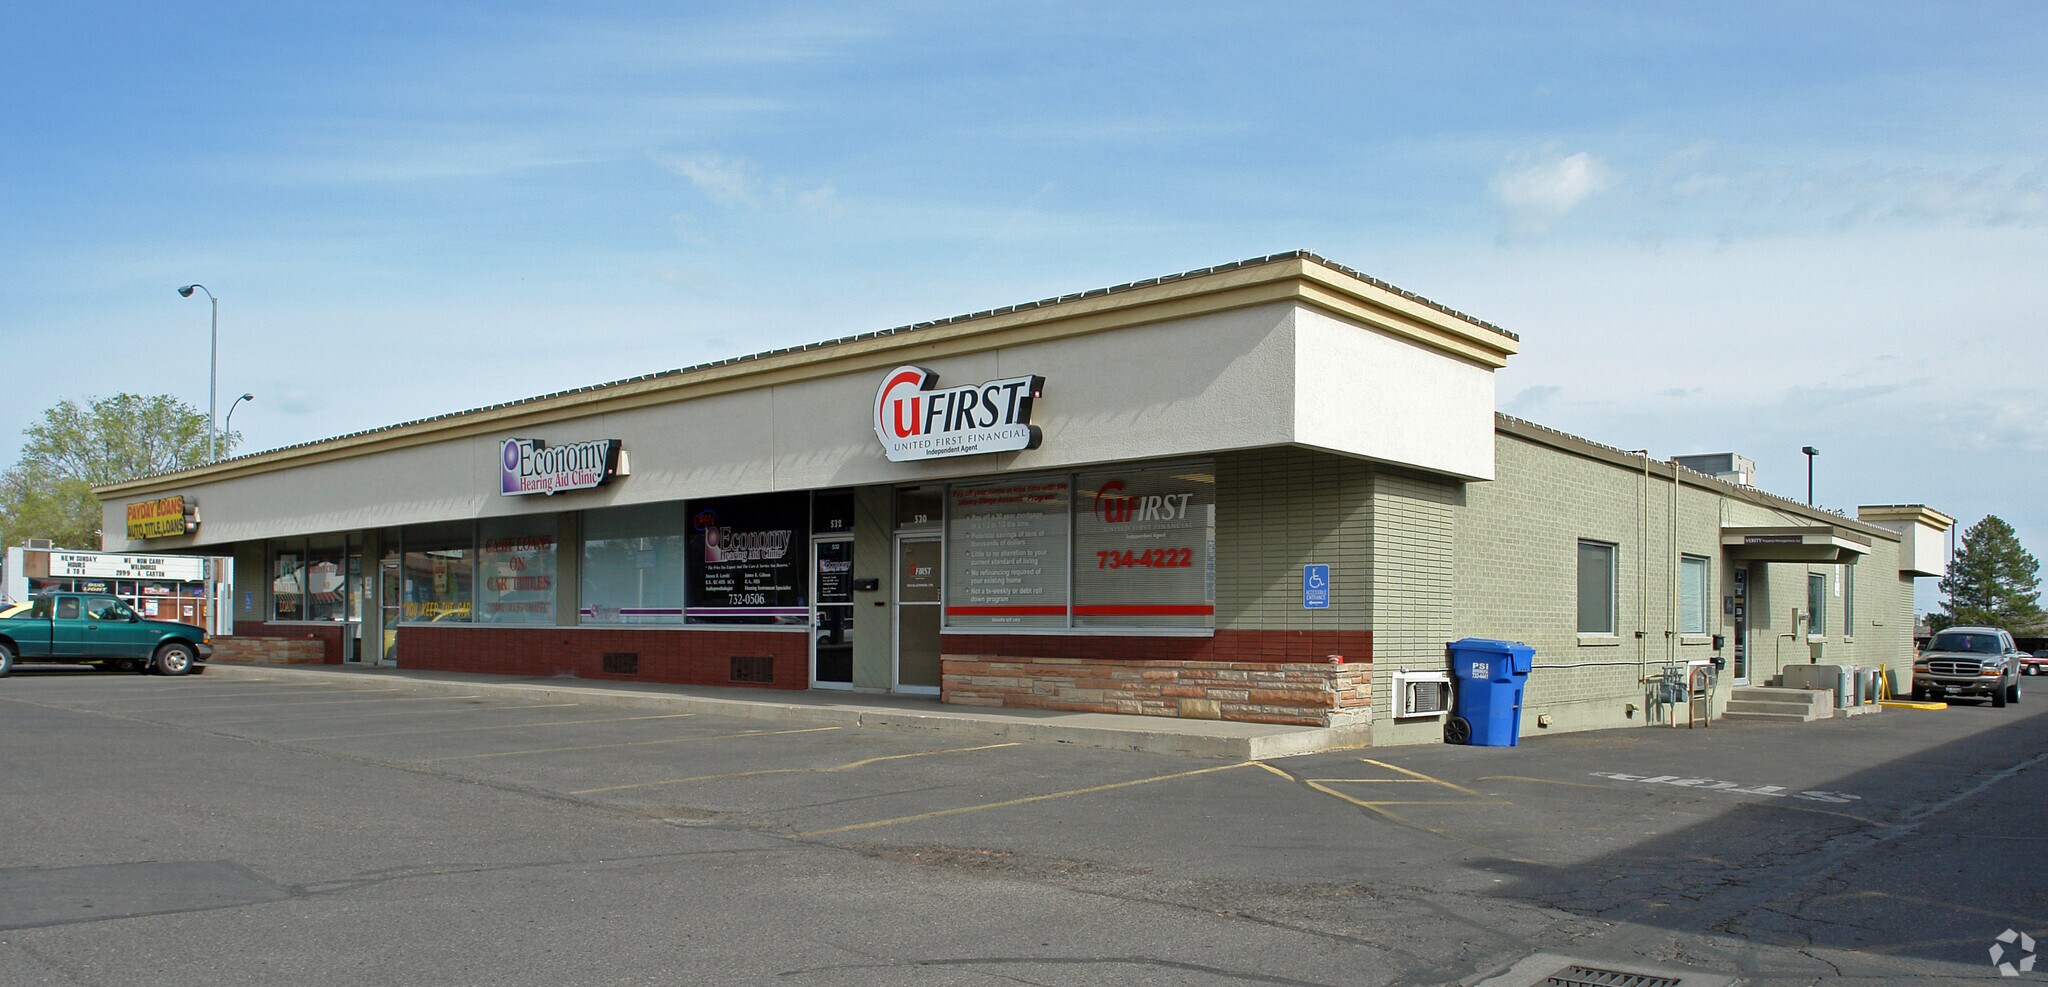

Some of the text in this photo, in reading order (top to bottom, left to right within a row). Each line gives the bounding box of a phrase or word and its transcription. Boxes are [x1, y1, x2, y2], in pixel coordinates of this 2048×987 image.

[894, 428, 1026, 451] UNITED FIRST FINANCIAL
[926, 444, 978, 456] Independent Agent
[520, 443, 608, 478] Economy
[520, 469, 597, 492] Hearing Aid Clinic
[128, 497, 183, 521] PAYDAY LOANS
[914, 514, 927, 524] 530
[1016, 512, 1043, 520] mortgage
[128, 517, 184, 538] AUTO TITLE LOANS
[830, 519, 842, 528] 532
[1154, 522, 1192, 530] FINANCIAL
[720, 526, 792, 556] Economy
[996, 531, 1017, 539] savings
[486, 536, 551, 553] CASH LOANS
[720, 549, 784, 562] Hearing Aid Clinic
[1022, 557, 1038, 566] living
[1096, 547, 1193, 570] 734-4222
[510, 557, 525, 571] ON
[1010, 568, 1034, 576] required
[486, 575, 550, 591] CAR TITLES
[984, 577, 1005, 585] existing
[986, 587, 1011, 595] bi-weekly
[728, 593, 765, 605] 732-0506
[1472, 662, 1489, 670] PSI
